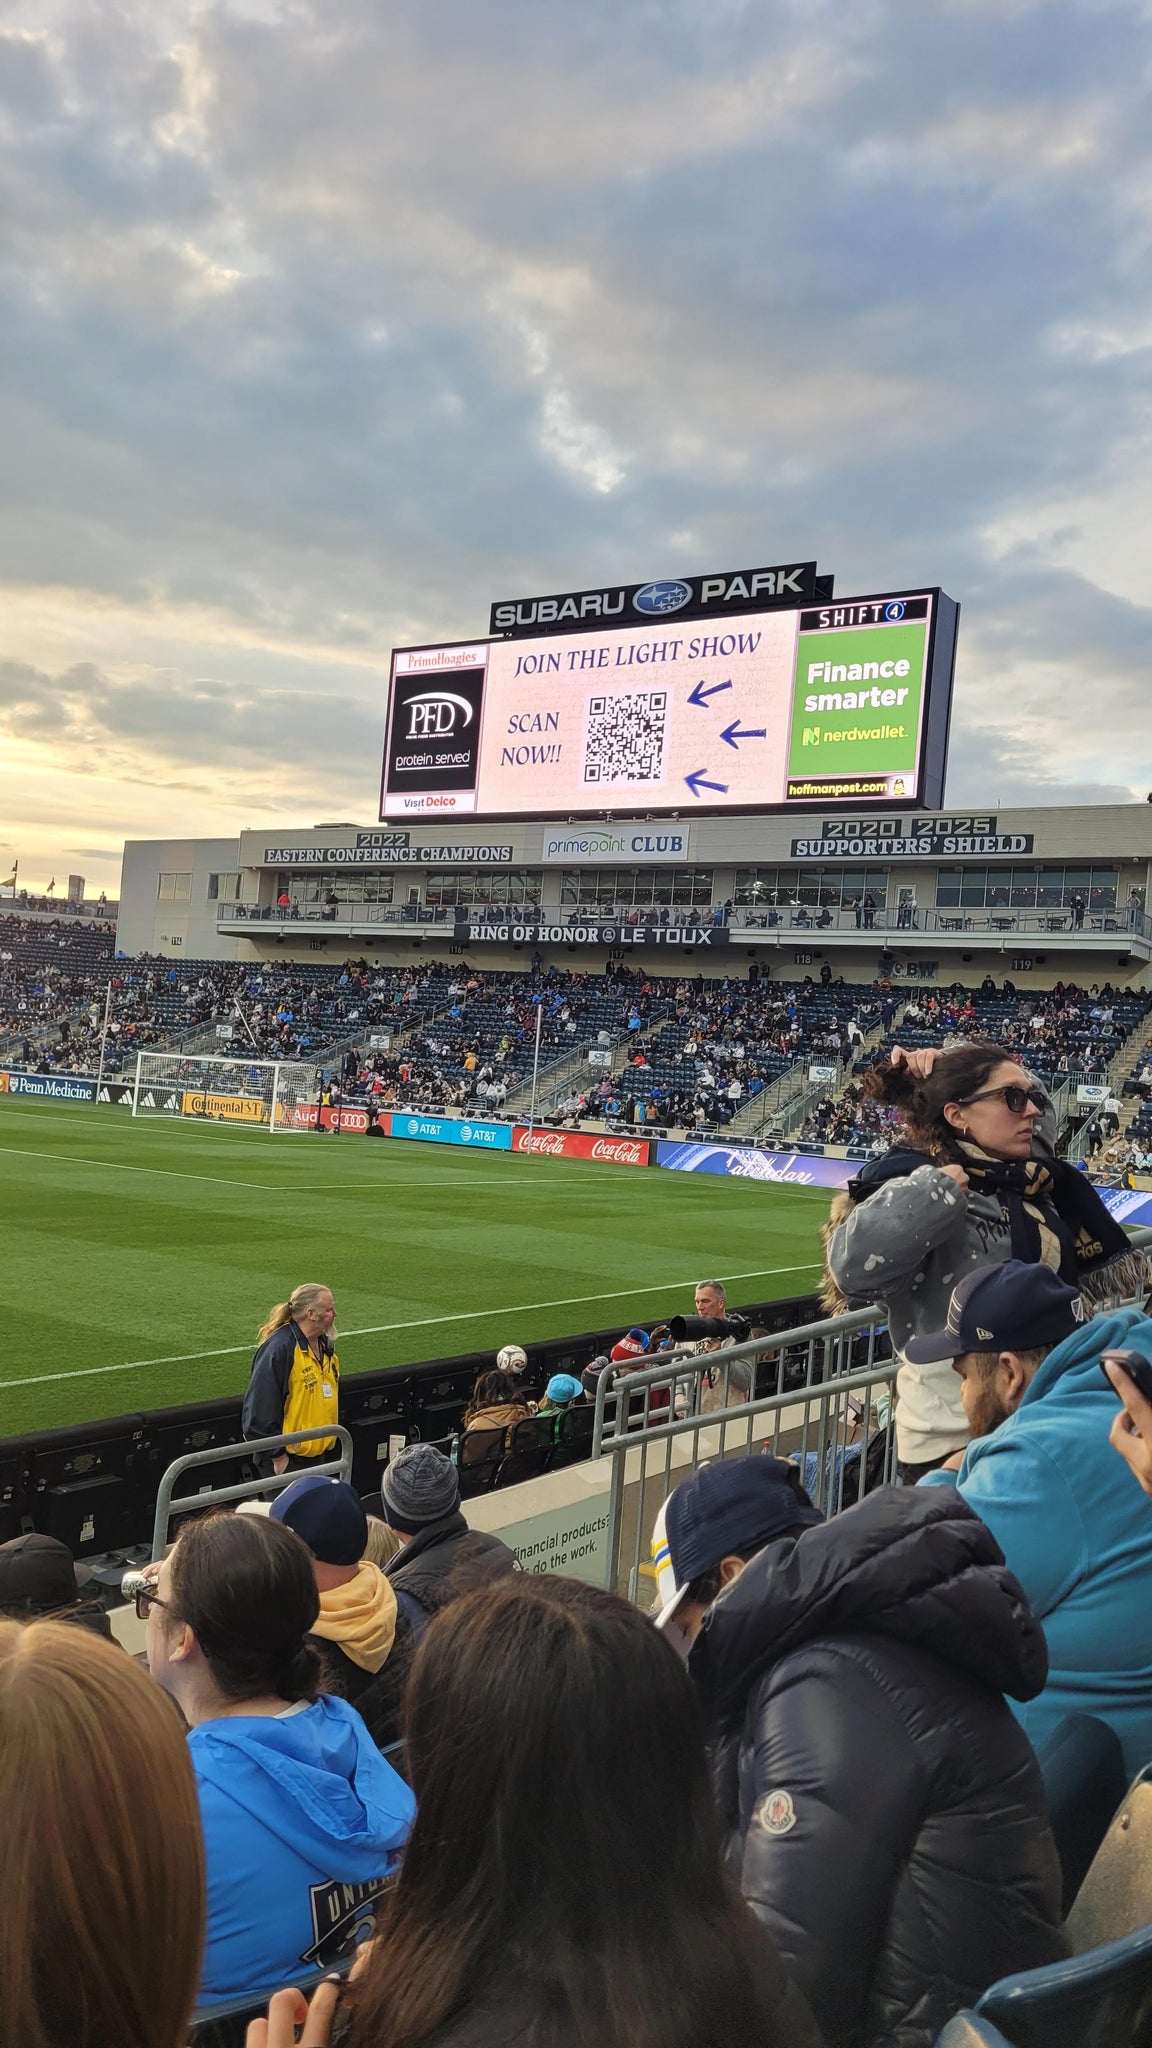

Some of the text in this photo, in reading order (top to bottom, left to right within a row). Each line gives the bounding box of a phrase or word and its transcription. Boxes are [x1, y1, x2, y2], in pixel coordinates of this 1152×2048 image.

[495, 568, 805, 628] SUBARU PARK
[408, 651, 477, 669] PrimoHoagies
[514, 632, 762, 678] JOIN THE LIGHT SHOW
[807, 658, 910, 685] Finance
[804, 686, 909, 712] smarter
[409, 701, 455, 734] PFD
[507, 711, 560, 734] SCAN
[824, 725, 905, 742] nerdwallet
[396, 750, 470, 768] protein served
[500, 744, 562, 766] NOW!!
[789, 780, 888, 797] hoffmanpest.com
[404, 796, 456, 807] Visit Delco
[827, 818, 990, 838] 2020 2025
[359, 834, 406, 847] 2022
[548, 836, 683, 857] primepoint CLUB
[796, 835, 1026, 856] SUPPORTERS' SHIELD
[266, 846, 511, 862] EASTERN CONFERENCE CHAMPIONS
[469, 925, 712, 944] RING OF HONOR LE TOUX
[796, 954, 811, 964] 118
[1013, 959, 1031, 970] 119
[19, 1077, 92, 1100] Penn Medicine
[294, 1109, 320, 1122] Aud
[419, 1123, 442, 1136] AT&T
[472, 1129, 497, 1142] AT&T
[591, 1139, 644, 1164] Coca-Cola
[513, 1514, 610, 1560] financial products?
[533, 1539, 598, 1574] do the work.
